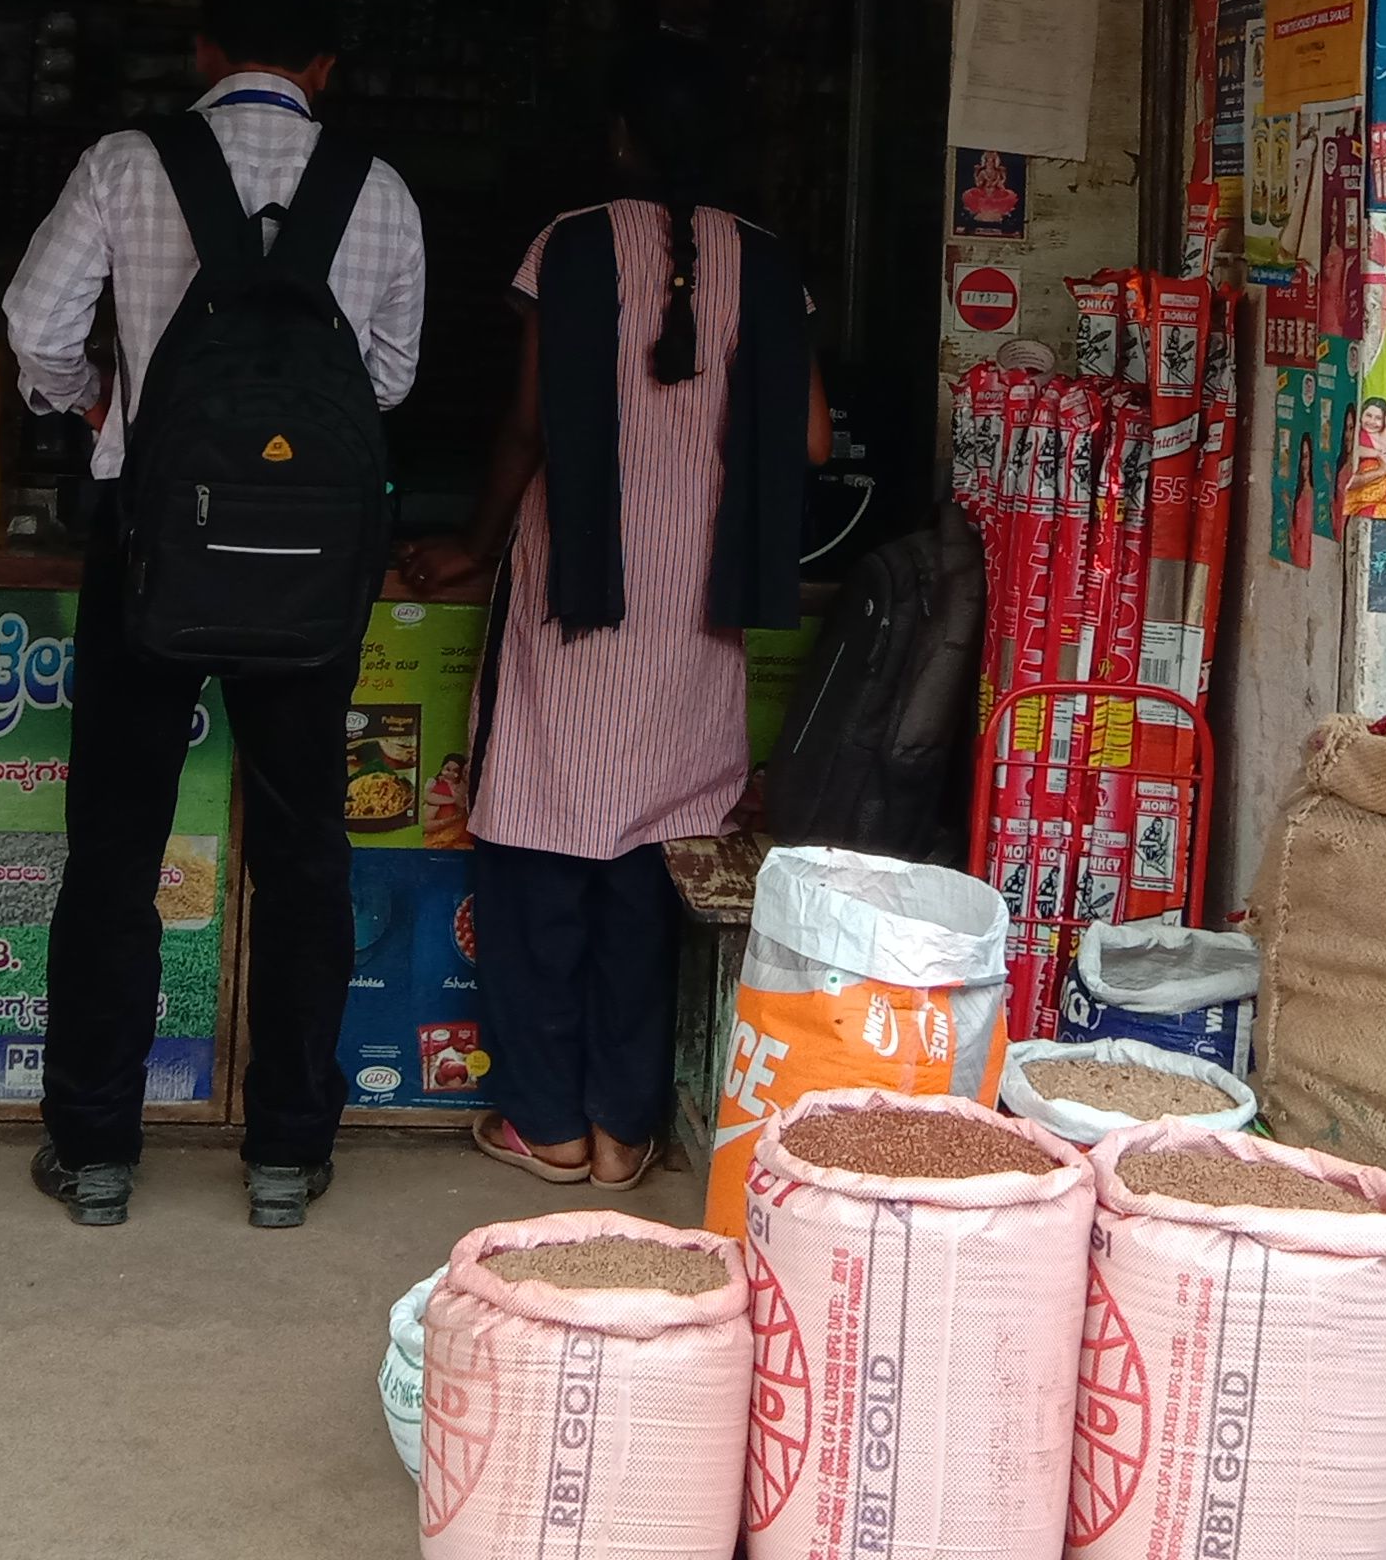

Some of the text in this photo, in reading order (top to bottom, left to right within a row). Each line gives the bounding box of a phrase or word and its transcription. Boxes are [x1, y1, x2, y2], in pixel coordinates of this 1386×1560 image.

[1151, 475, 1190, 504] 55
[1089, 857, 1122, 872] NKEY
[860, 992, 885, 1049] NICE
[932, 1010, 948, 1062] NICE
[723, 1018, 791, 1117] CE
[548, 1332, 603, 1531] RBT GOLD
[859, 1352, 900, 1557] RBT GOLD
[1202, 1368, 1250, 1560] RBT GOLD
